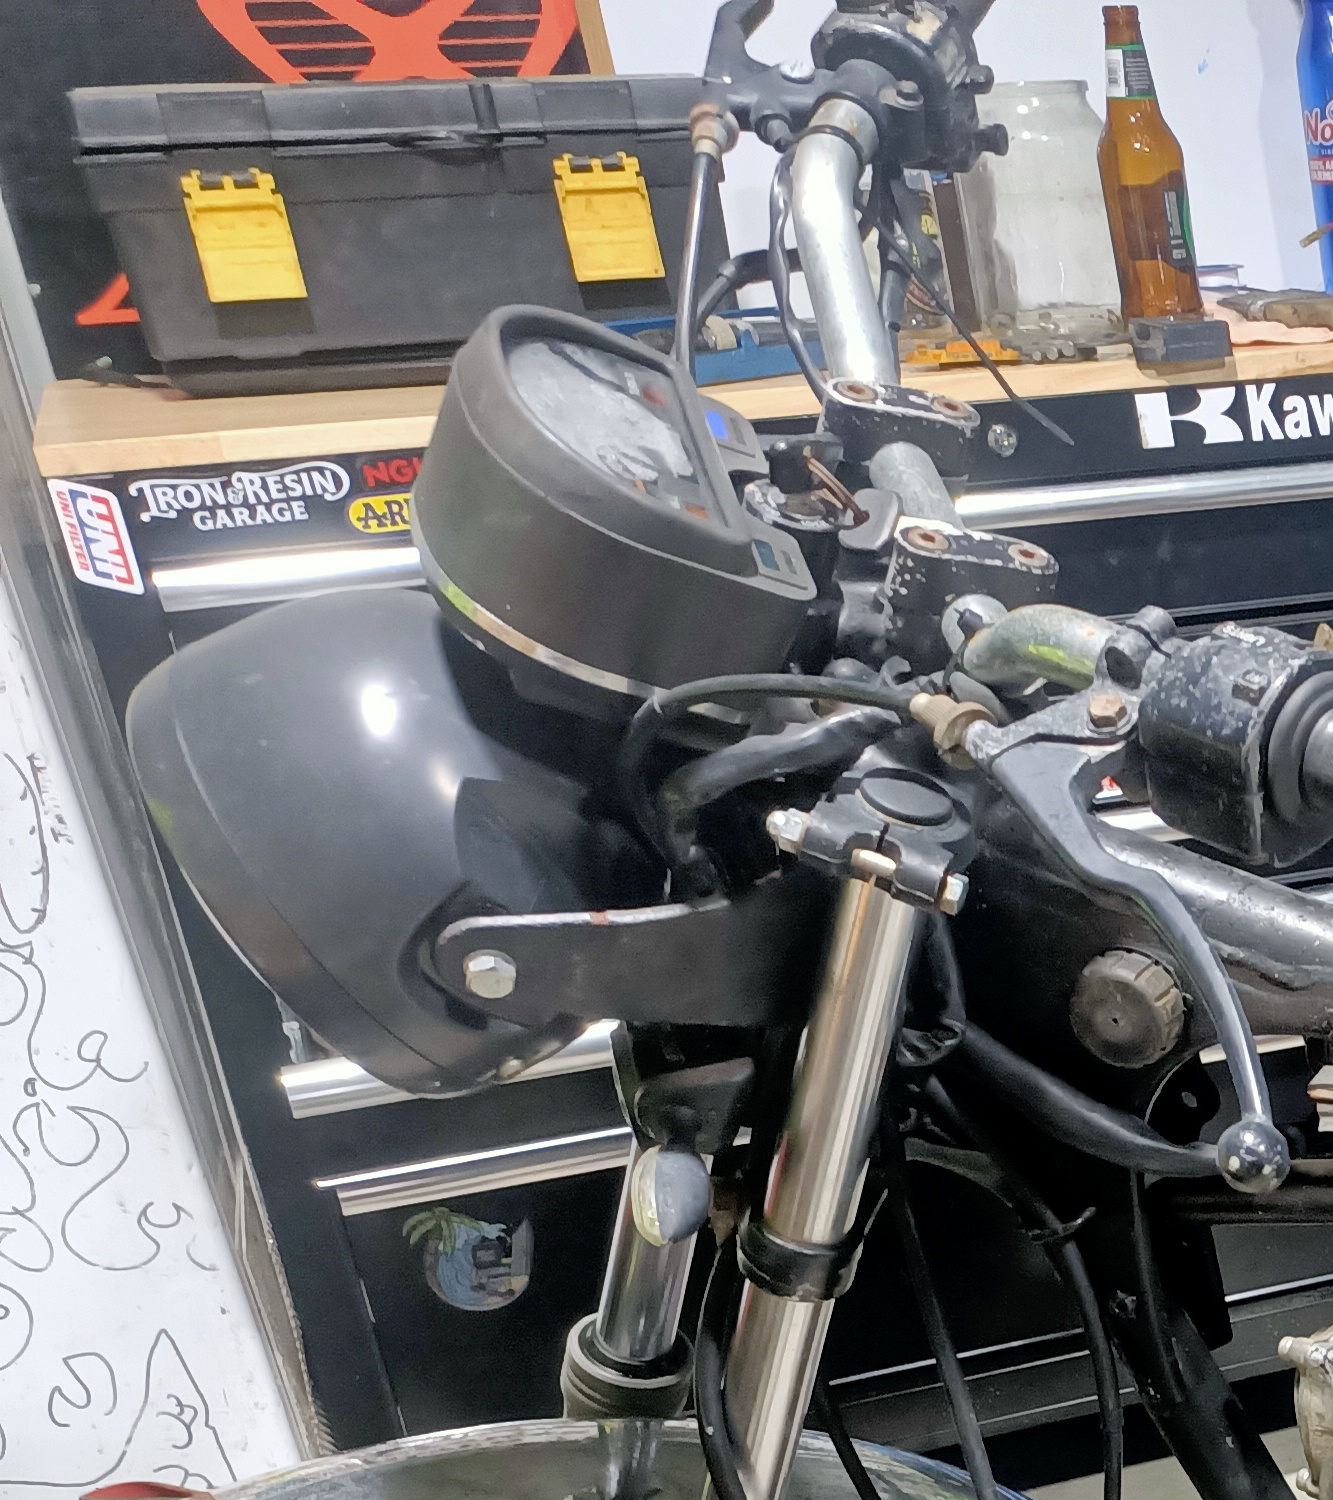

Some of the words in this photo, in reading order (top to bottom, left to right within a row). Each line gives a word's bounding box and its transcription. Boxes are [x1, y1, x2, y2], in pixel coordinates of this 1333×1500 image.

[128, 476, 229, 522] IRON
[231, 461, 350, 503] RESIN
[193, 501, 309, 532] GARAGE
[357, 498, 411, 529] AR
